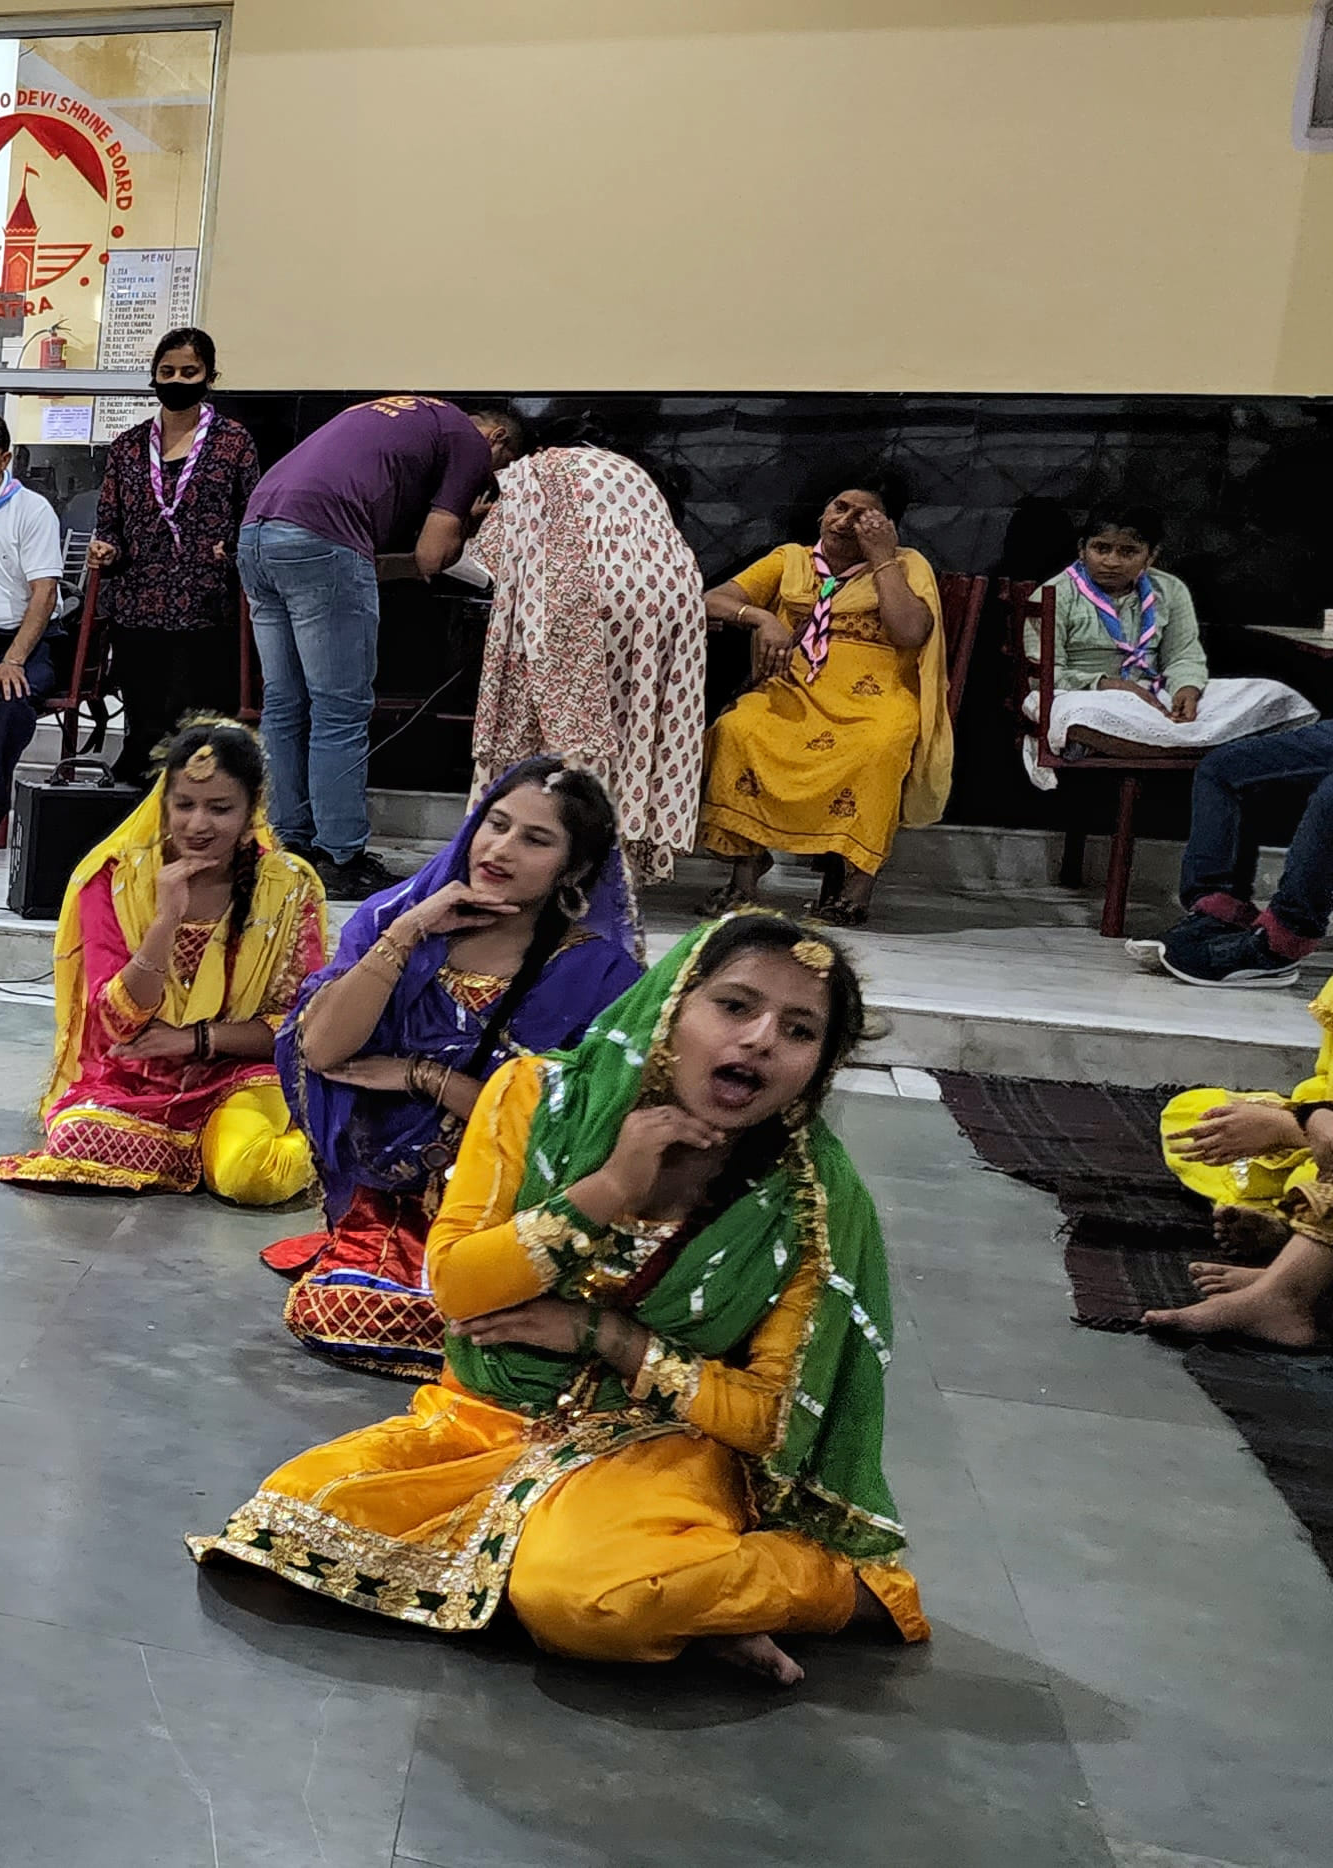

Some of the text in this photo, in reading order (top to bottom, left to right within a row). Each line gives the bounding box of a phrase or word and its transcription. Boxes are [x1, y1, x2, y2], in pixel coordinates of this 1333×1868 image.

[17, 90, 57, 108] DEVI
[57, 97, 113, 142] SHRINE
[106, 140, 133, 211] BOARD
[141, 253, 172, 262] MENU
